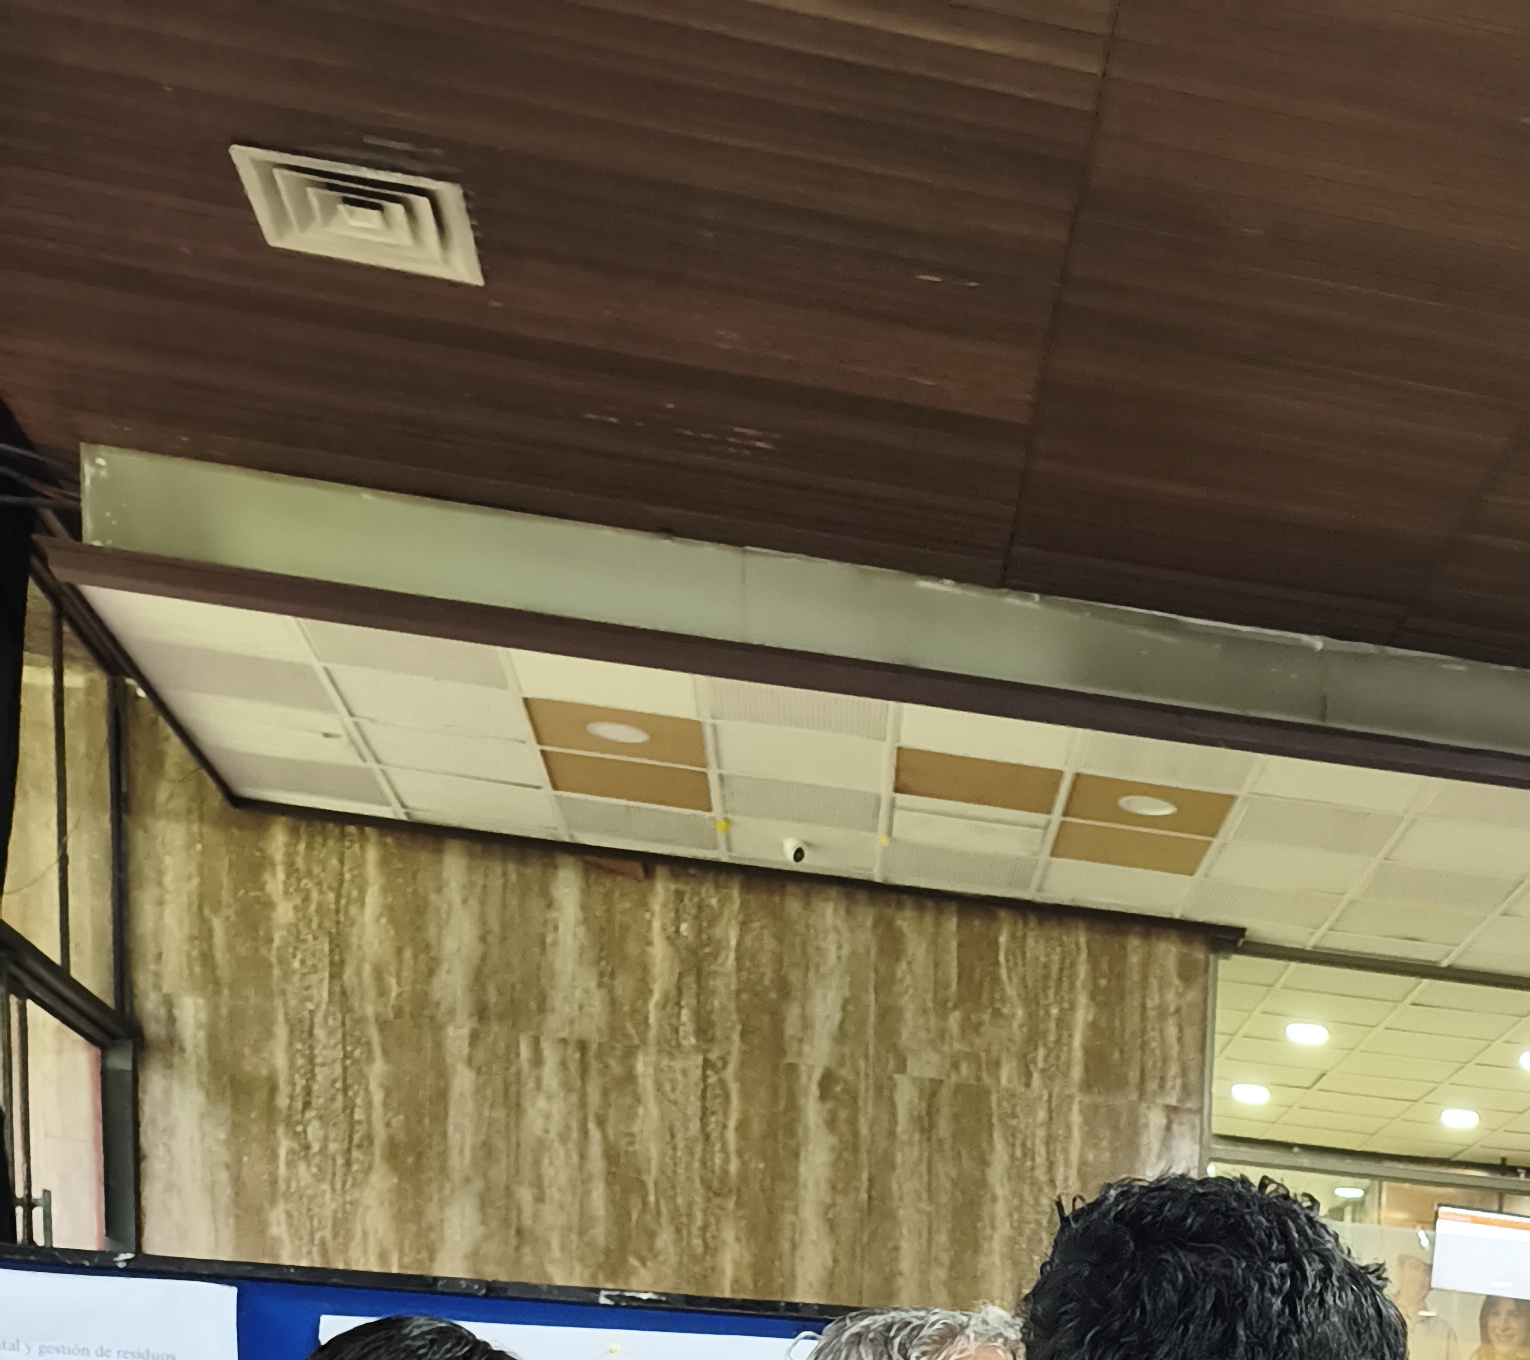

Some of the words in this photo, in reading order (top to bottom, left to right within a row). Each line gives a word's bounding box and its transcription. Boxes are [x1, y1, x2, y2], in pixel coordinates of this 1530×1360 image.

[25, 1342, 33, 1356] y
[38, 1342, 90, 1357] gestión
[95, 1345, 112, 1358] de
